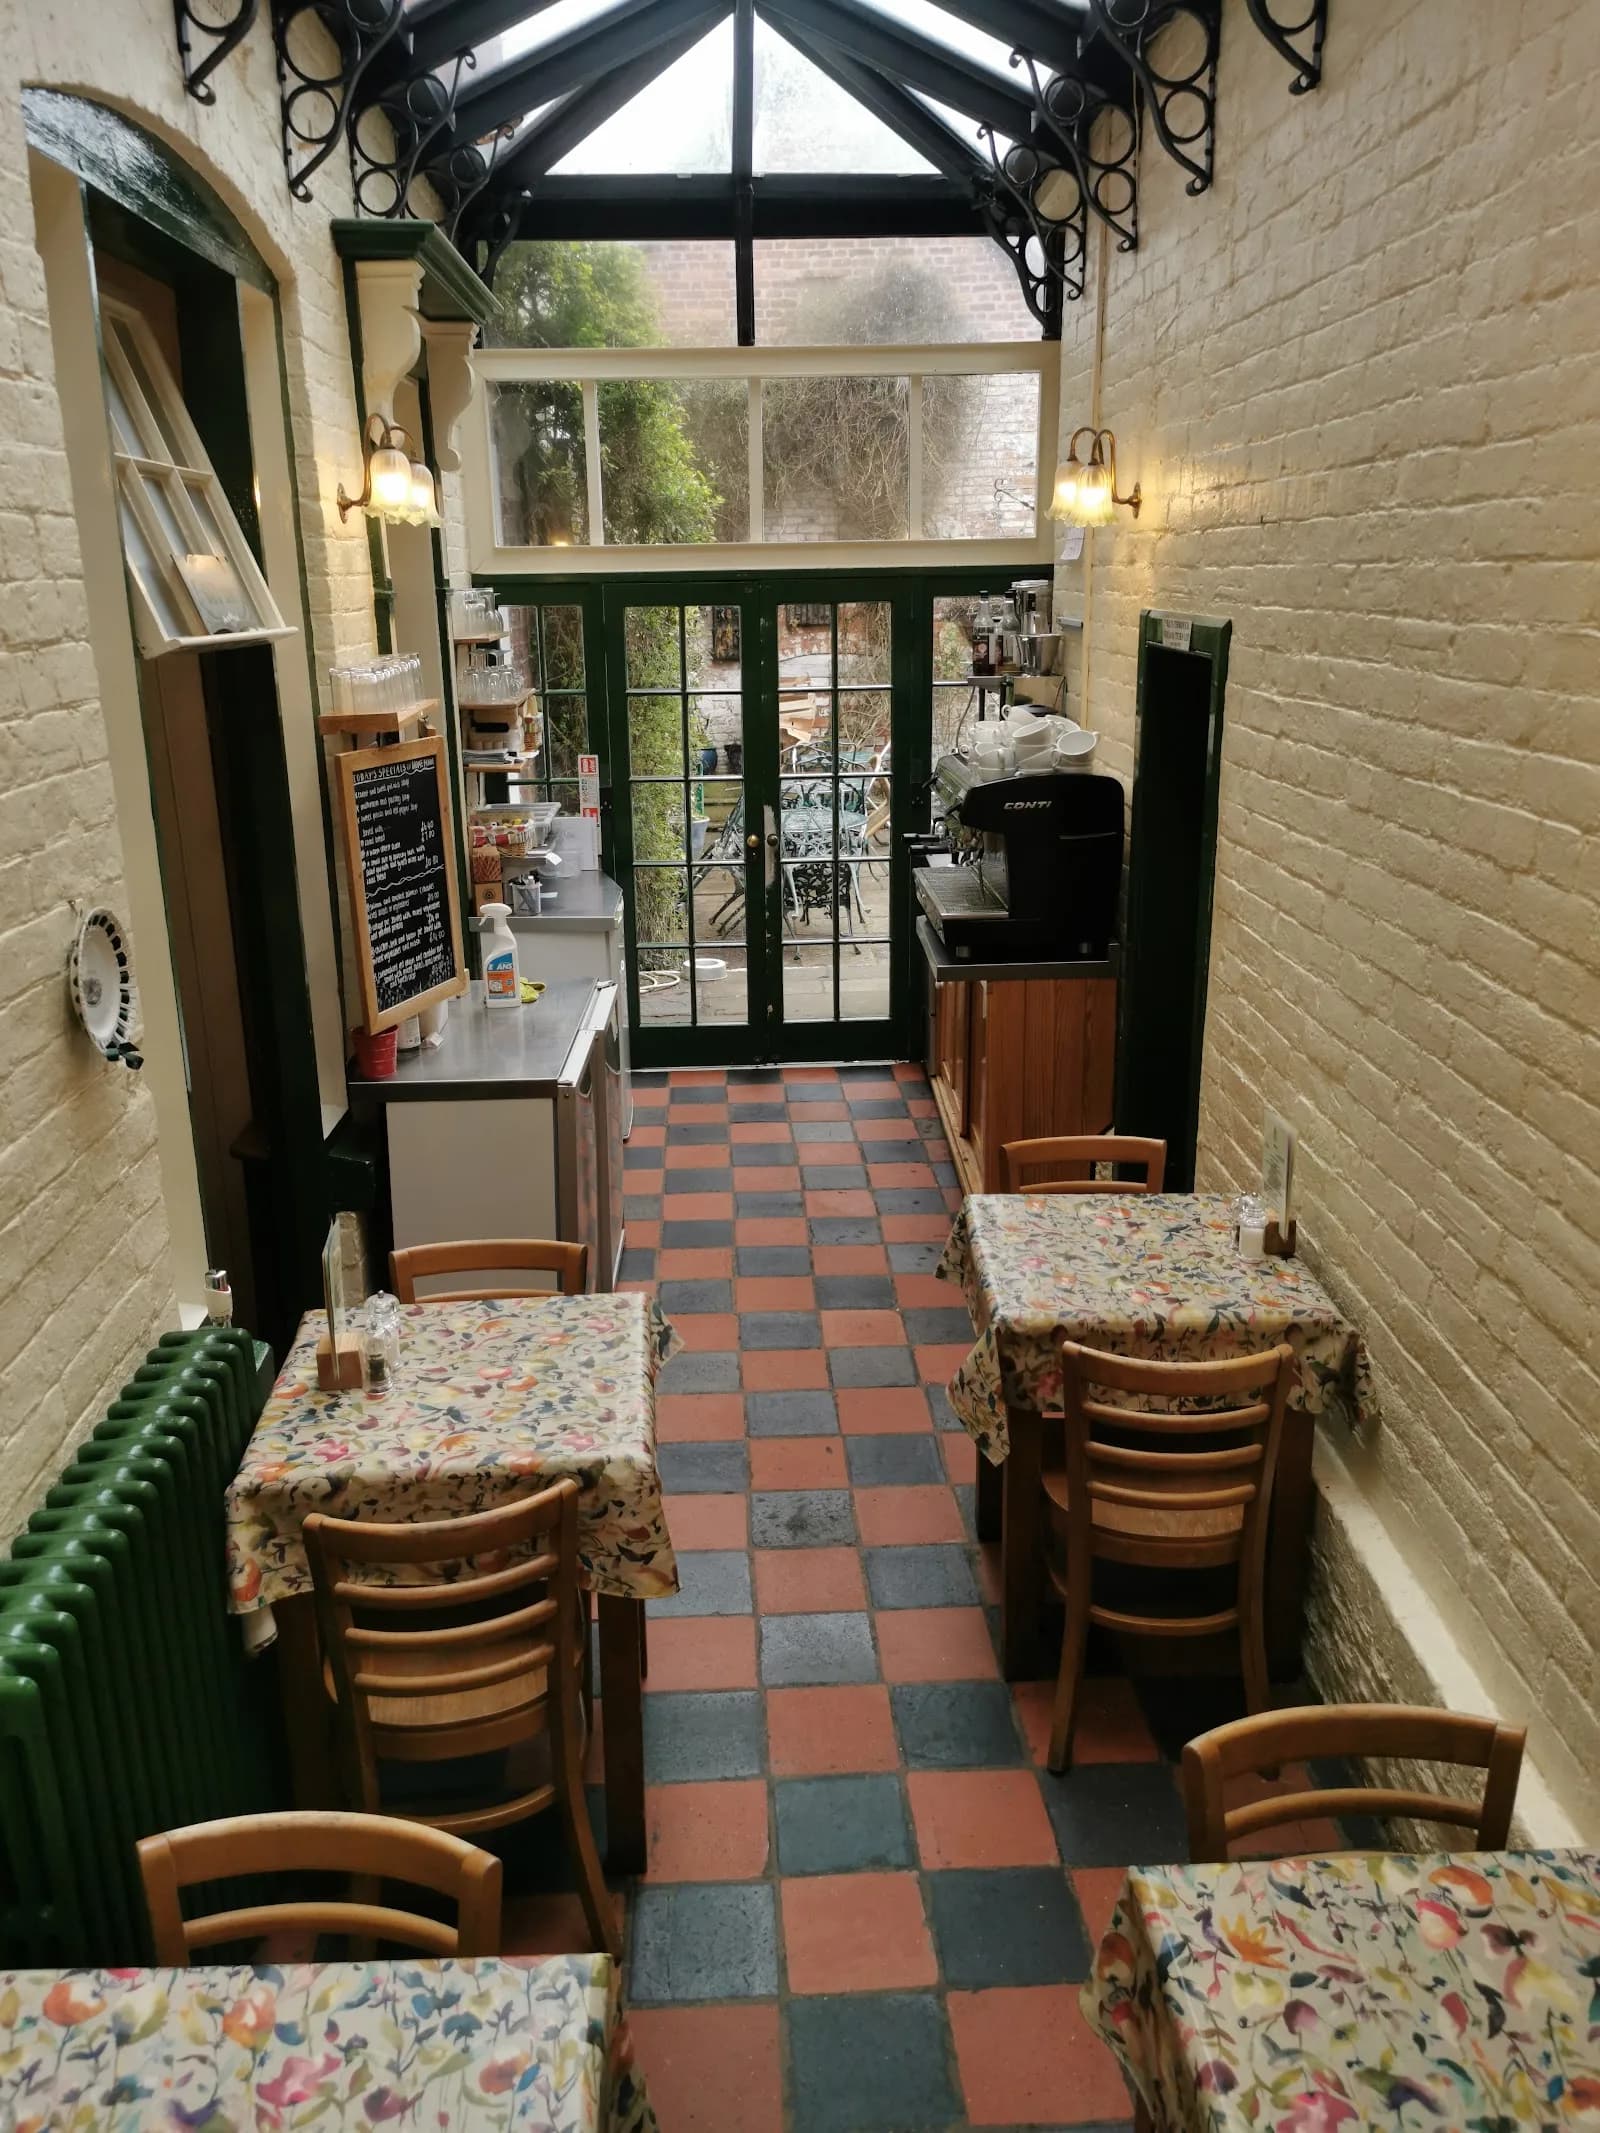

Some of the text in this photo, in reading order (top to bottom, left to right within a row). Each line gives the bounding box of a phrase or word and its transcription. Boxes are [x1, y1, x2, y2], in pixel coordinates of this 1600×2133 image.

[353, 771, 377, 783] TODAY'S
[378, 763, 406, 778] SPECIALS
[1003, 801, 1052, 810] CONTI
[488, 962, 513, 971] EANS
